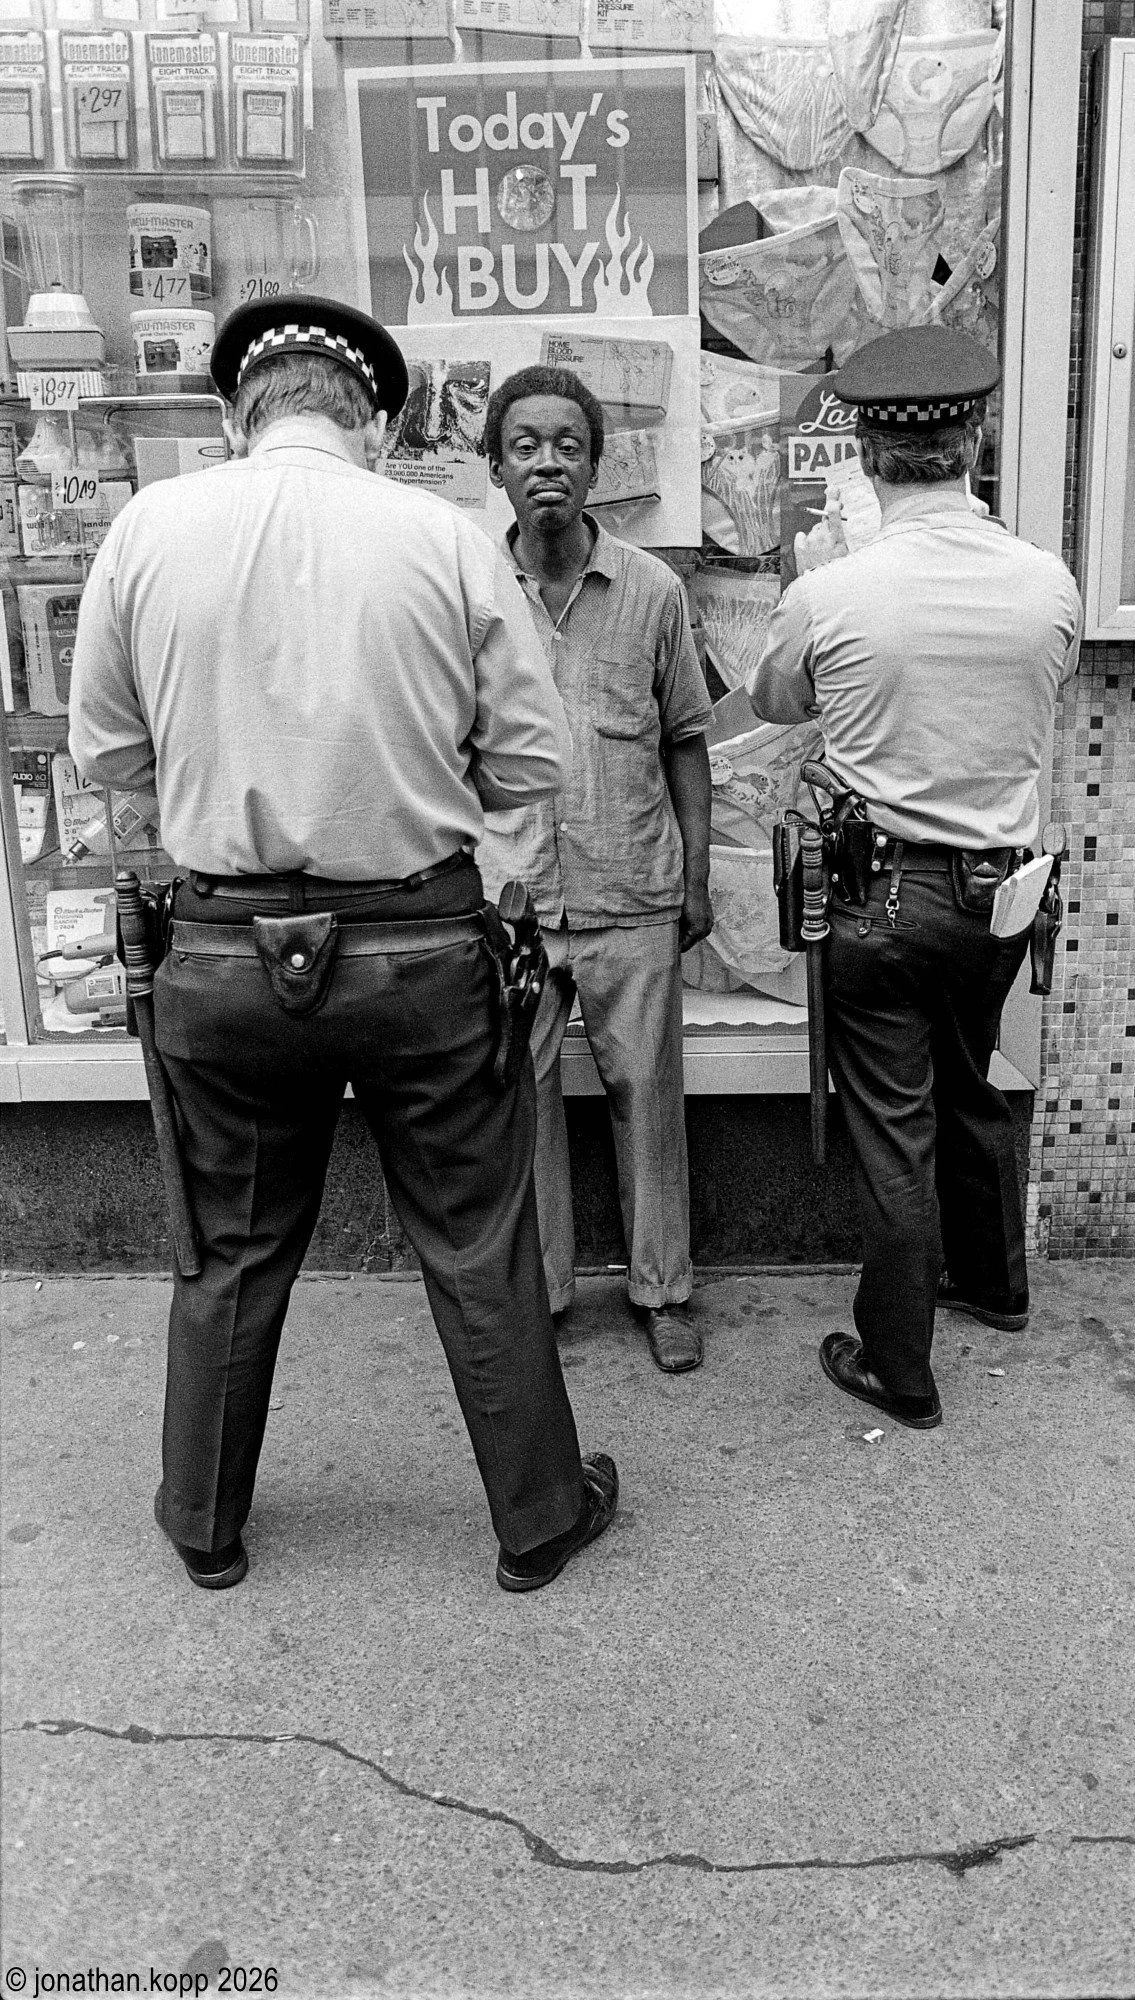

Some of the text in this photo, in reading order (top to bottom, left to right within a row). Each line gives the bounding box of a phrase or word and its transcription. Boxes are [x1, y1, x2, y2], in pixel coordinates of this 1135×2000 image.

[64, 42, 128, 61] tonemaster
[151, 44, 214, 63] tonemaster
[233, 43, 297, 64] tonemaster
[416, 91, 630, 160] Today's
[457, 241, 600, 310] BUY
[547, 354, 584, 363] PRESSURE
[385, 462, 397, 470] Are
[435, 465, 446, 473] the
[400, 477, 447, 486] hypertension?
[420, 472, 454, 480] Americans
[13, 772, 33, 781] AUDIO
